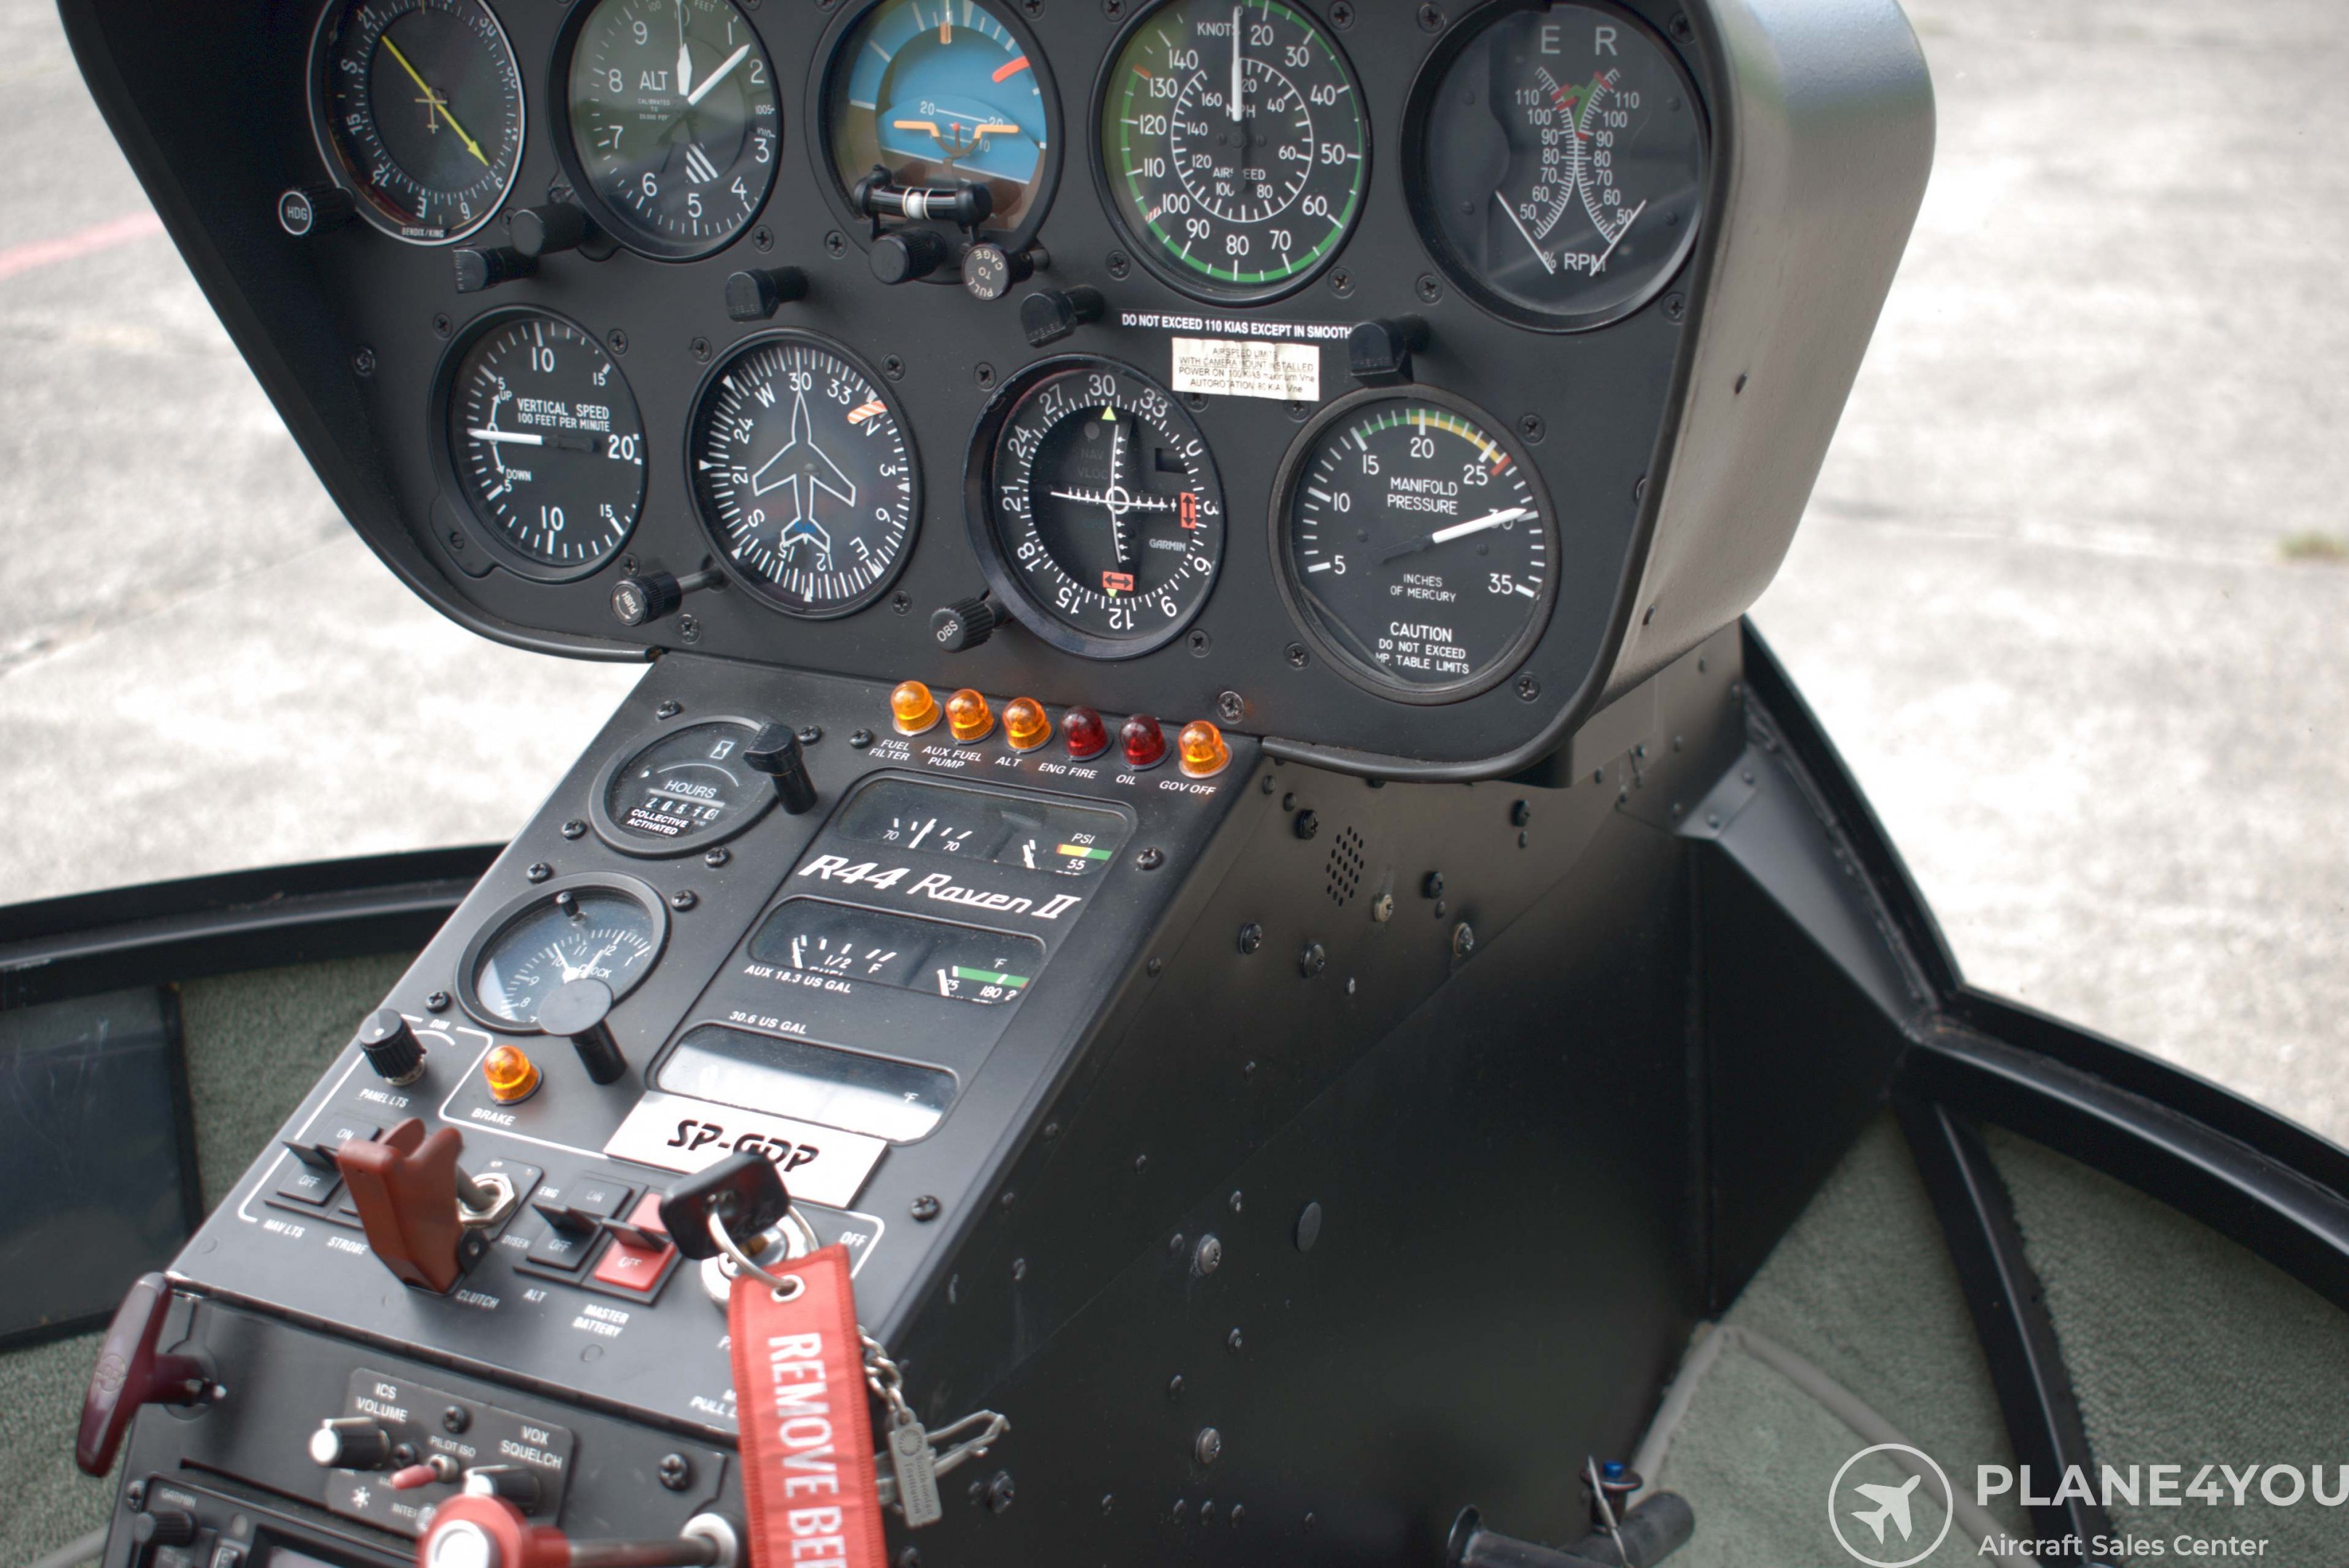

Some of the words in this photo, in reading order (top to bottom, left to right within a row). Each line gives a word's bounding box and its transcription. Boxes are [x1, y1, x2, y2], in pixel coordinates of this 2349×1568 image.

[1250, 25, 1274, 46] 20
[1168, 49, 1199, 71] 140
[1285, 46, 1308, 68] 30
[639, 70, 668, 91] ALT
[1149, 78, 1178, 99] 130
[1310, 85, 1335, 107] 40
[1515, 89, 1539, 106] 110
[1614, 91, 1640, 110] 110
[1139, 115, 1167, 136] 120
[1527, 109, 1551, 126] 100
[1603, 111, 1627, 128] 100
[1541, 128, 1558, 145] 90
[1321, 143, 1346, 166] 50
[1542, 148, 1559, 165] 80
[1144, 158, 1165, 179] 110
[1213, 167, 1266, 181] AIREED
[1540, 168, 1557, 184] 70
[1162, 193, 1190, 215] 100
[1532, 186, 1550, 203] 60
[287, 207, 308, 221] HDG
[1302, 195, 1328, 217] 60
[1520, 203, 1536, 220] 50
[402, 226, 444, 239] BENDIX/KING
[1186, 219, 1210, 240] 90
[1226, 235, 1249, 256] 80
[1269, 229, 1292, 252] 70
[974, 249, 1004, 272] CAGE
[1564, 253, 1606, 272] RPM
[977, 266, 991, 281] TO
[966, 277, 993, 298] PULL
[1122, 314, 1137, 327] DO
[1139, 315, 1160, 328] NOT
[1162, 317, 1203, 331] EXCEED
[1205, 319, 1223, 333] 110
[1224, 320, 1249, 334] KIAS
[1251, 322, 1292, 338] EXCEPT
[1294, 326, 1306, 338] IN
[1307, 326, 1351, 339] SMOOTH
[532, 347, 555, 372] 10
[1179, 356, 1200, 365] WITH
[1203, 358, 1237, 367] CAMERA
[789, 372, 812, 391] 30
[1179, 367, 1210, 377] POWER
[1213, 369, 1224, 377] ON
[754, 383, 776, 408] W
[827, 378, 852, 405] 33
[1088, 374, 1116, 397] 30
[500, 391, 513, 401] UP
[1039, 383, 1063, 415] 27
[1139, 387, 1170, 419] 33
[517, 397, 569, 417] VERTICAL
[576, 404, 609, 420] SPEED
[518, 412, 534, 425] 100
[535, 415, 557, 427] FEET
[559, 417, 577, 429] PER
[579, 419, 610, 432] MINUTE
[733, 417, 754, 444] 24
[608, 434, 635, 461] 20
[1008, 425, 1032, 458] 24
[1410, 438, 1434, 459] 20
[1363, 454, 1380, 475] 15
[506, 469, 532, 481] DOWN
[731, 466, 749, 484] 21
[1463, 464, 1489, 486] 25
[1391, 477, 1458, 497] MANIFOLD
[1001, 485, 1021, 513] 21
[1333, 492, 1351, 513] 10
[1387, 494, 1458, 515] PRESSURE
[542, 505, 564, 531] 10
[1149, 539, 1186, 552] GARMIN
[1017, 542, 1042, 572] 18
[1334, 555, 1346, 575] 5
[1404, 573, 1442, 587] INCHES
[1488, 573, 1513, 595] 35
[1056, 587, 1080, 616] 15
[1391, 586, 1404, 596] OF
[1408, 587, 1457, 603] MERCURY
[1108, 608, 1134, 630] 12
[937, 618, 959, 643] OBS
[1390, 622, 1452, 642] CAUTION
[1379, 638, 1393, 650] DO
[1399, 640, 1419, 653] NOT
[1425, 645, 1466, 660] EXCEED
[1396, 655, 1430, 670] TABLE
[1436, 661, 1469, 674] LIMITS
[869, 748, 910, 761] FILTER
[881, 739, 910, 751] FUEL
[922, 745, 950, 757] AUX
[951, 748, 982, 762] FUEL
[927, 756, 965, 769] PUMP
[995, 756, 1022, 767] ALT
[1038, 763, 1066, 776] ENG
[1068, 767, 1098, 780] FIRE
[664, 780, 717, 799] HOURS
[1116, 774, 1136, 785] OIL
[1160, 780, 1189, 793] GOV
[1189, 784, 1216, 797] OFF
[627, 817, 678, 836] ACTIVATED
[631, 809, 689, 828] COLLECTIVE
[882, 829, 900, 841] 70
[1071, 833, 1096, 844] PSI
[943, 840, 961, 852] 70
[798, 854, 910, 890] R44
[907, 873, 1032, 914] Raven
[1032, 894, 1081, 919] II
[579, 964, 612, 979] COCK
[824, 955, 852, 969] 1/2
[744, 965, 771, 979] AUX
[775, 969, 802, 983] 18.3
[804, 976, 823, 988] US
[824, 979, 851, 994] GAL
[980, 985, 1001, 999] 180
[429, 1018, 450, 1030] DIM
[729, 1010, 757, 1024] 30.6
[759, 1016, 778, 1029] US
[780, 1020, 807, 1034] GAL
[359, 1088, 391, 1106] PANEL
[388, 1094, 409, 1108] LTS
[471, 1107, 516, 1126] BRAKE
[667, 1119, 820, 1172] SP-GDP
[297, 1175, 321, 1188] OFF
[538, 1186, 560, 1199] ENG
[263, 1219, 286, 1233] NAV
[285, 1225, 306, 1238] LTS
[839, 1230, 868, 1247] OFF
[327, 1236, 368, 1255] STROBE
[548, 1238, 572, 1252] OFF
[618, 1256, 643, 1268] OFF
[455, 1289, 500, 1310] CLUTCH
[524, 1289, 547, 1302] ALT
[584, 1303, 629, 1324] MASTER
[572, 1316, 624, 1337] BATTERY
[375, 1382, 396, 1400] ICS
[354, 1395, 408, 1423] VOLUME
[689, 1395, 725, 1416] PULL
[768, 1332, 839, 1499] REMOVE
[521, 1424, 550, 1445] VOX
[429, 1434, 458, 1452] PILOT
[458, 1442, 476, 1458] ISO
[500, 1439, 563, 1469] SQUELCH
